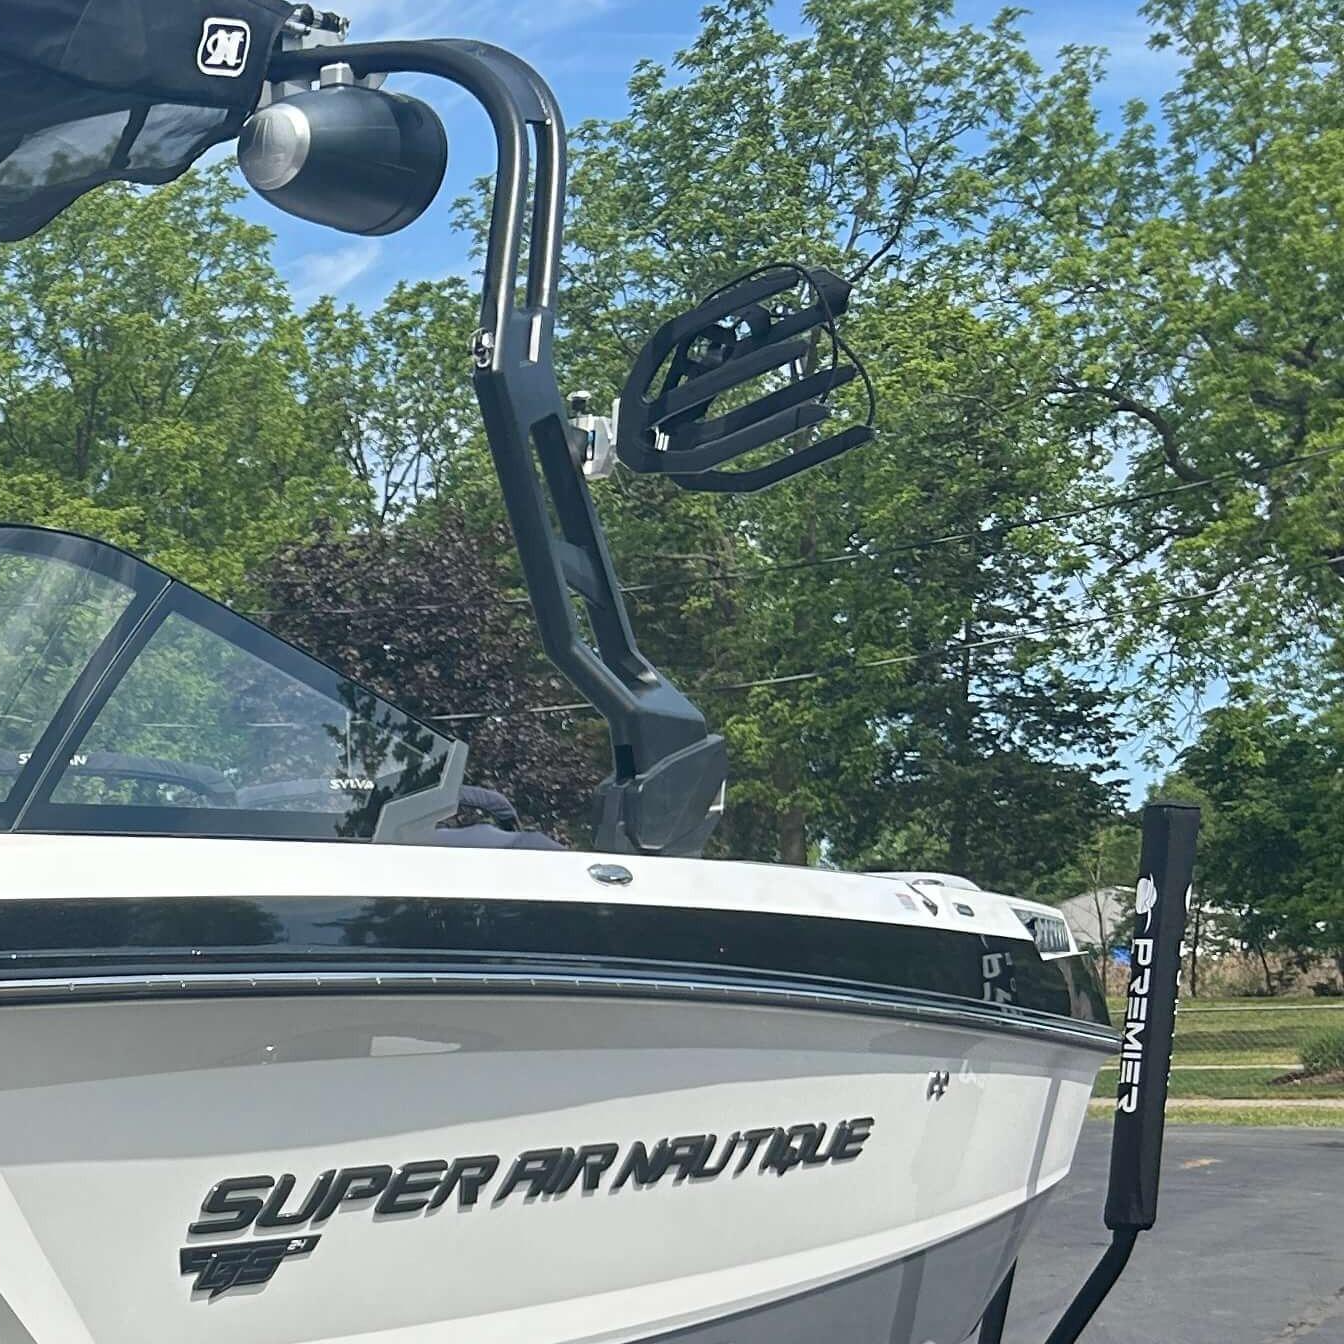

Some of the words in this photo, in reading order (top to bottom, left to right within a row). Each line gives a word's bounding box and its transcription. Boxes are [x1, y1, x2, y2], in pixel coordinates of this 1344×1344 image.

[1118, 938, 1154, 1113] PREMIER
[188, 1154, 500, 1235] SUPER
[497, 1141, 622, 1199] AIR
[616, 1116, 875, 1193] NAUTIQUE
[287, 1238, 309, 1251] 24
